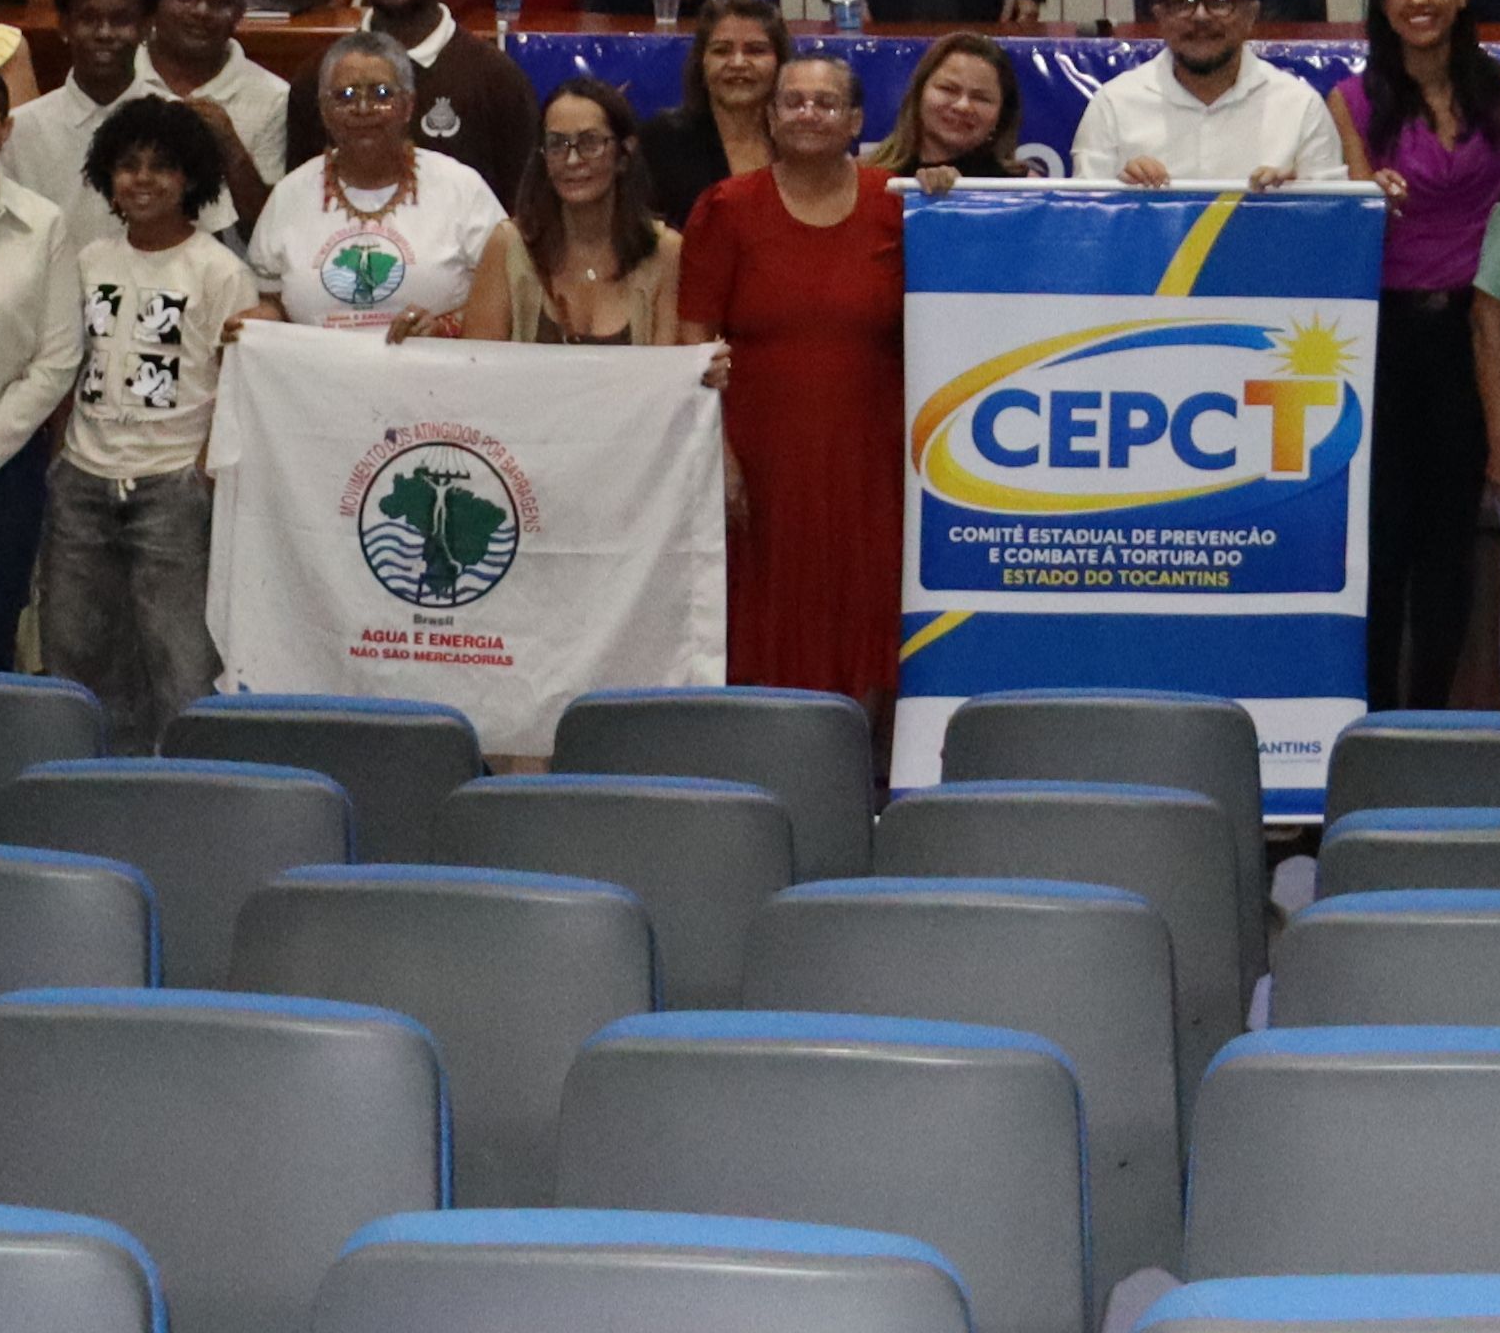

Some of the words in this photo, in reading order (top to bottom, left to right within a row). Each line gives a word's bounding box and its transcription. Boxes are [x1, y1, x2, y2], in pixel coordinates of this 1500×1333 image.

[971, 379, 1338, 472] CEPCT
[340, 443, 387, 517] MOVIMENTO
[385, 427, 413, 452] DOS
[413, 422, 481, 445] ATINGIDOS
[481, 435, 506, 462] POR
[501, 455, 540, 533] BARRAGENS
[1029, 528, 1127, 545] ESTADUAL
[1131, 529, 1157, 545] DE
[989, 547, 1000, 564] E
[1004, 547, 1099, 564] COMBATE
[1120, 548, 1209, 565] TORTURA
[1213, 550, 1242, 566] DO
[1003, 569, 1079, 585] ESTADO
[1084, 569, 1113, 585] DO
[1117, 570, 1229, 587] TOCANTINS
[413, 614, 454, 626] Brasil
[414, 632, 425, 645] E
[429, 633, 504, 649] ENERGIA
[413, 651, 513, 666] MERCADORIAS
[1259, 741, 1322, 754] ANTINS
